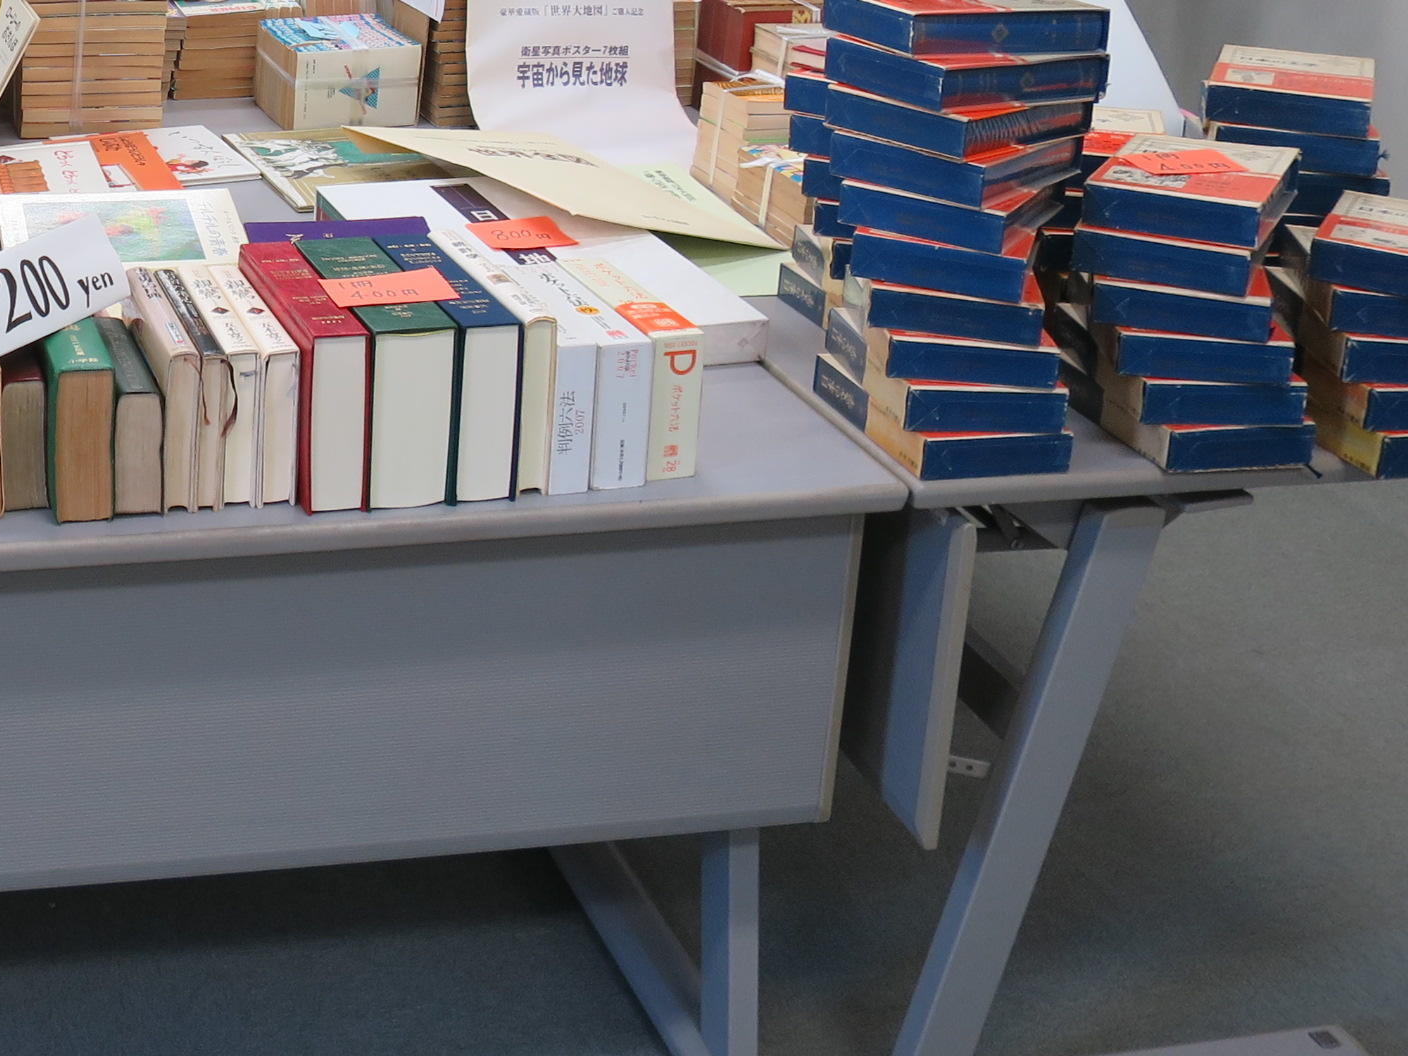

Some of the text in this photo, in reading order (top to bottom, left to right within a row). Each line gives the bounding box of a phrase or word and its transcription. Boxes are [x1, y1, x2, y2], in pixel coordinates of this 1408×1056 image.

[520, 44, 630, 57] 衛星写真ポスター7枚組
[515, 61, 629, 89] 宇宙から見た地球
[77, 270, 114, 309] yen
[664, 349, 697, 376] P
[556, 390, 575, 455] 判例六法
[574, 409, 585, 435] 2007
